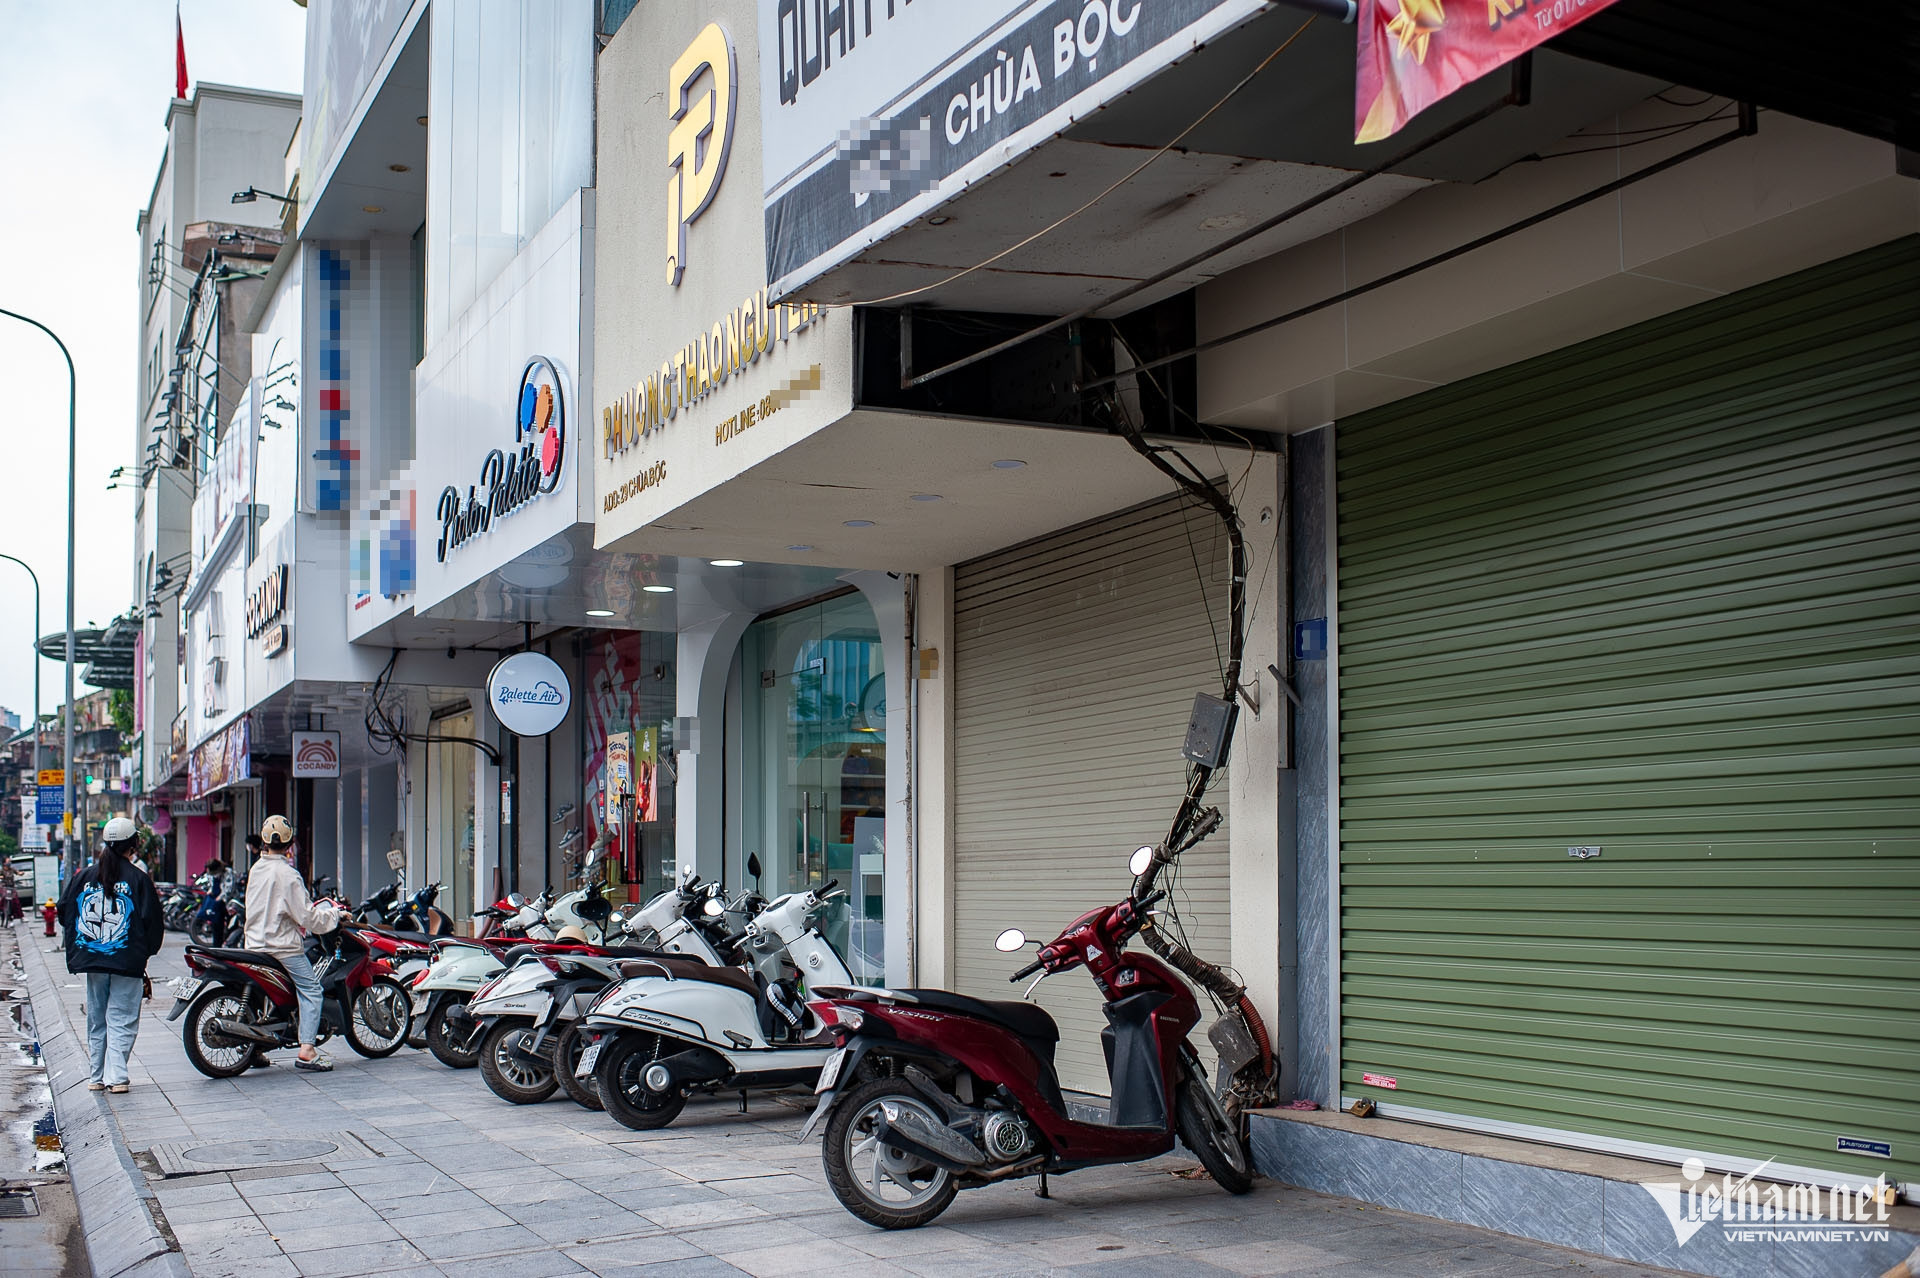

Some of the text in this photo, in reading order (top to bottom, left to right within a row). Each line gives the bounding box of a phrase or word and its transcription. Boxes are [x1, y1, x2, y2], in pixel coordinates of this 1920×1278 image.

[945, 44, 1042, 146] CHÙA
[499, 686, 558, 702] Palette Air
[297, 762, 337, 770] COCANDY
